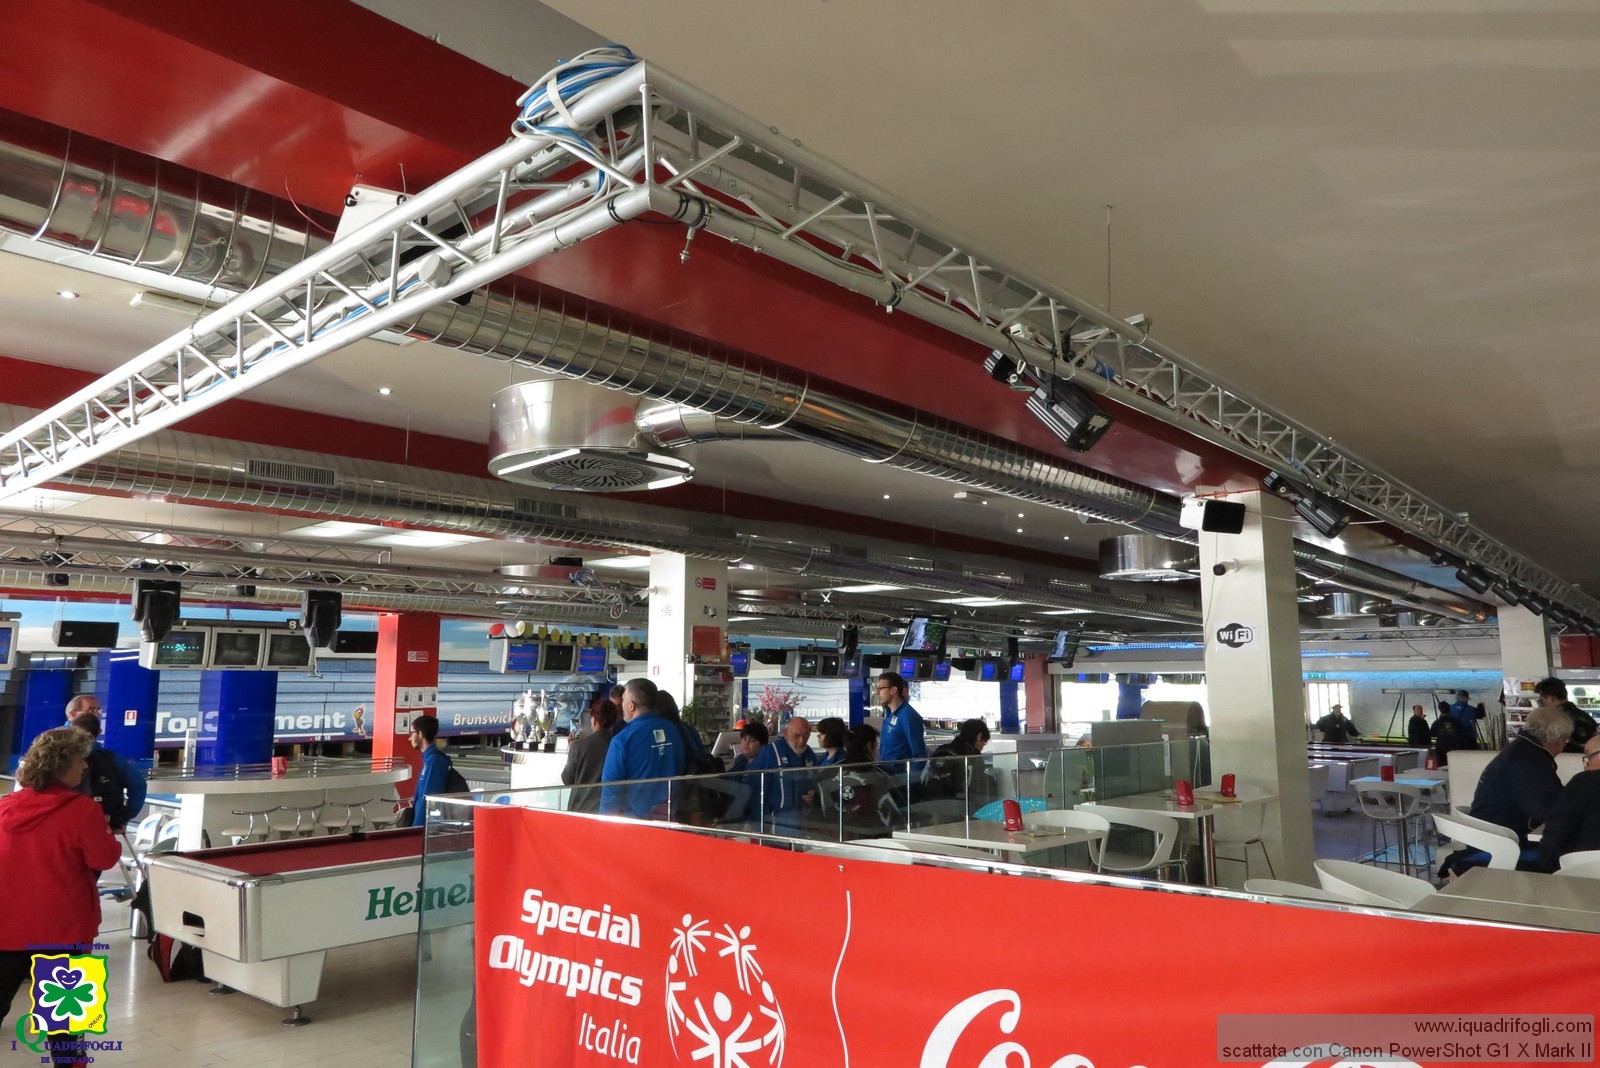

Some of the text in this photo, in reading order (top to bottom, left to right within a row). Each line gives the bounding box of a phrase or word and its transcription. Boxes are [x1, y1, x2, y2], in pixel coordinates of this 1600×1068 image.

[288, 620, 297, 630] 8
[521, 888, 640, 948] Special
[488, 934, 643, 1006] Olympics
[578, 1012, 641, 1065] Italia
